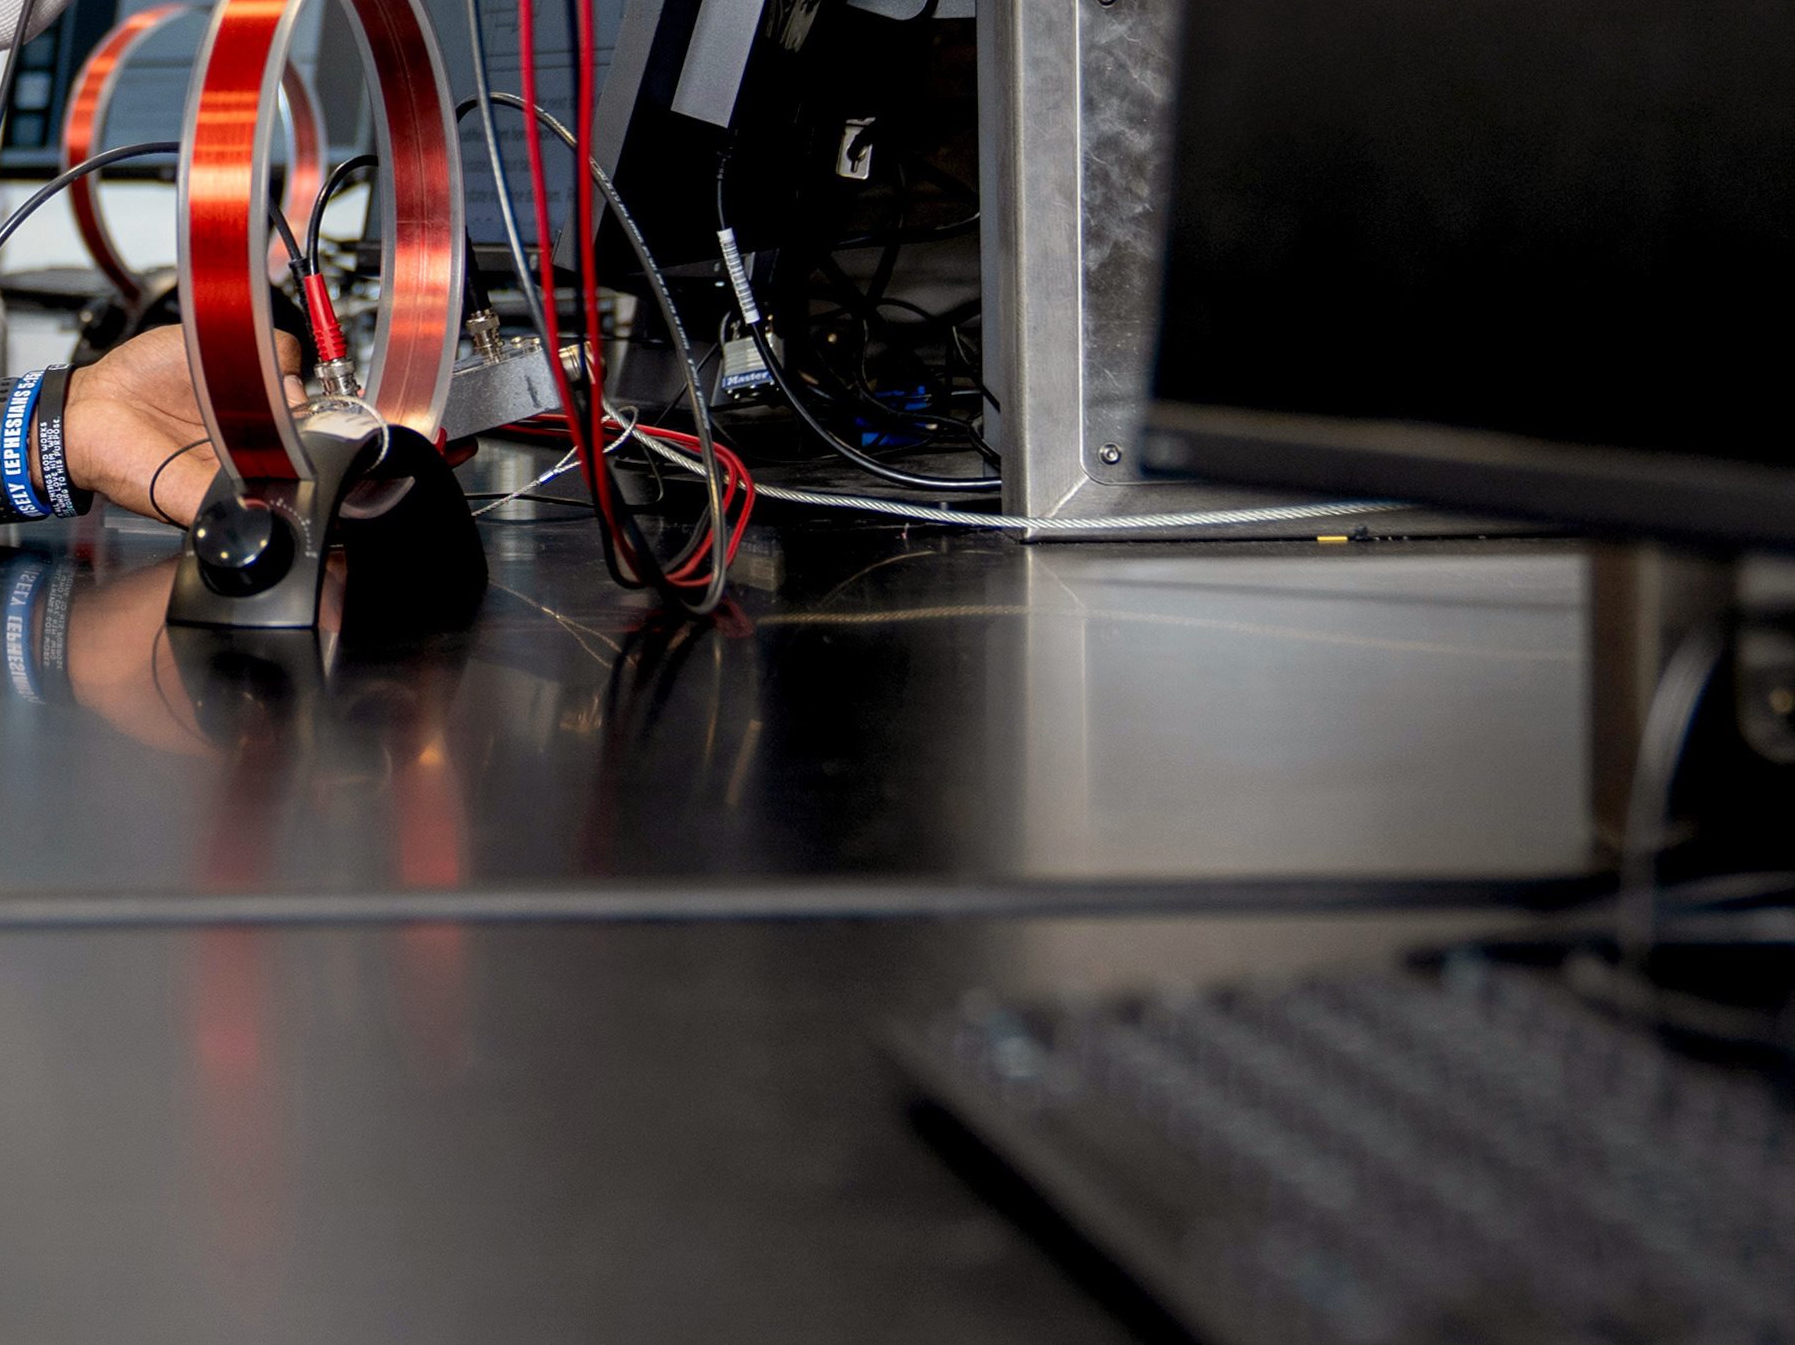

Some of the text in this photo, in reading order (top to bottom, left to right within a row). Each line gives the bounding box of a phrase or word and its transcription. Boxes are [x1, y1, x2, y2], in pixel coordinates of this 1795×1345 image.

[726, 371, 769, 386] Master
[3, 390, 31, 475] (EPHESIANS
[40, 422, 48, 451] WORKS
[42, 454, 50, 471] GOD
[56, 459, 64, 473] HIS
[44, 474, 56, 502] THINGS
[51, 472, 61, 491] LOVE
[58, 476, 67, 486] TO
